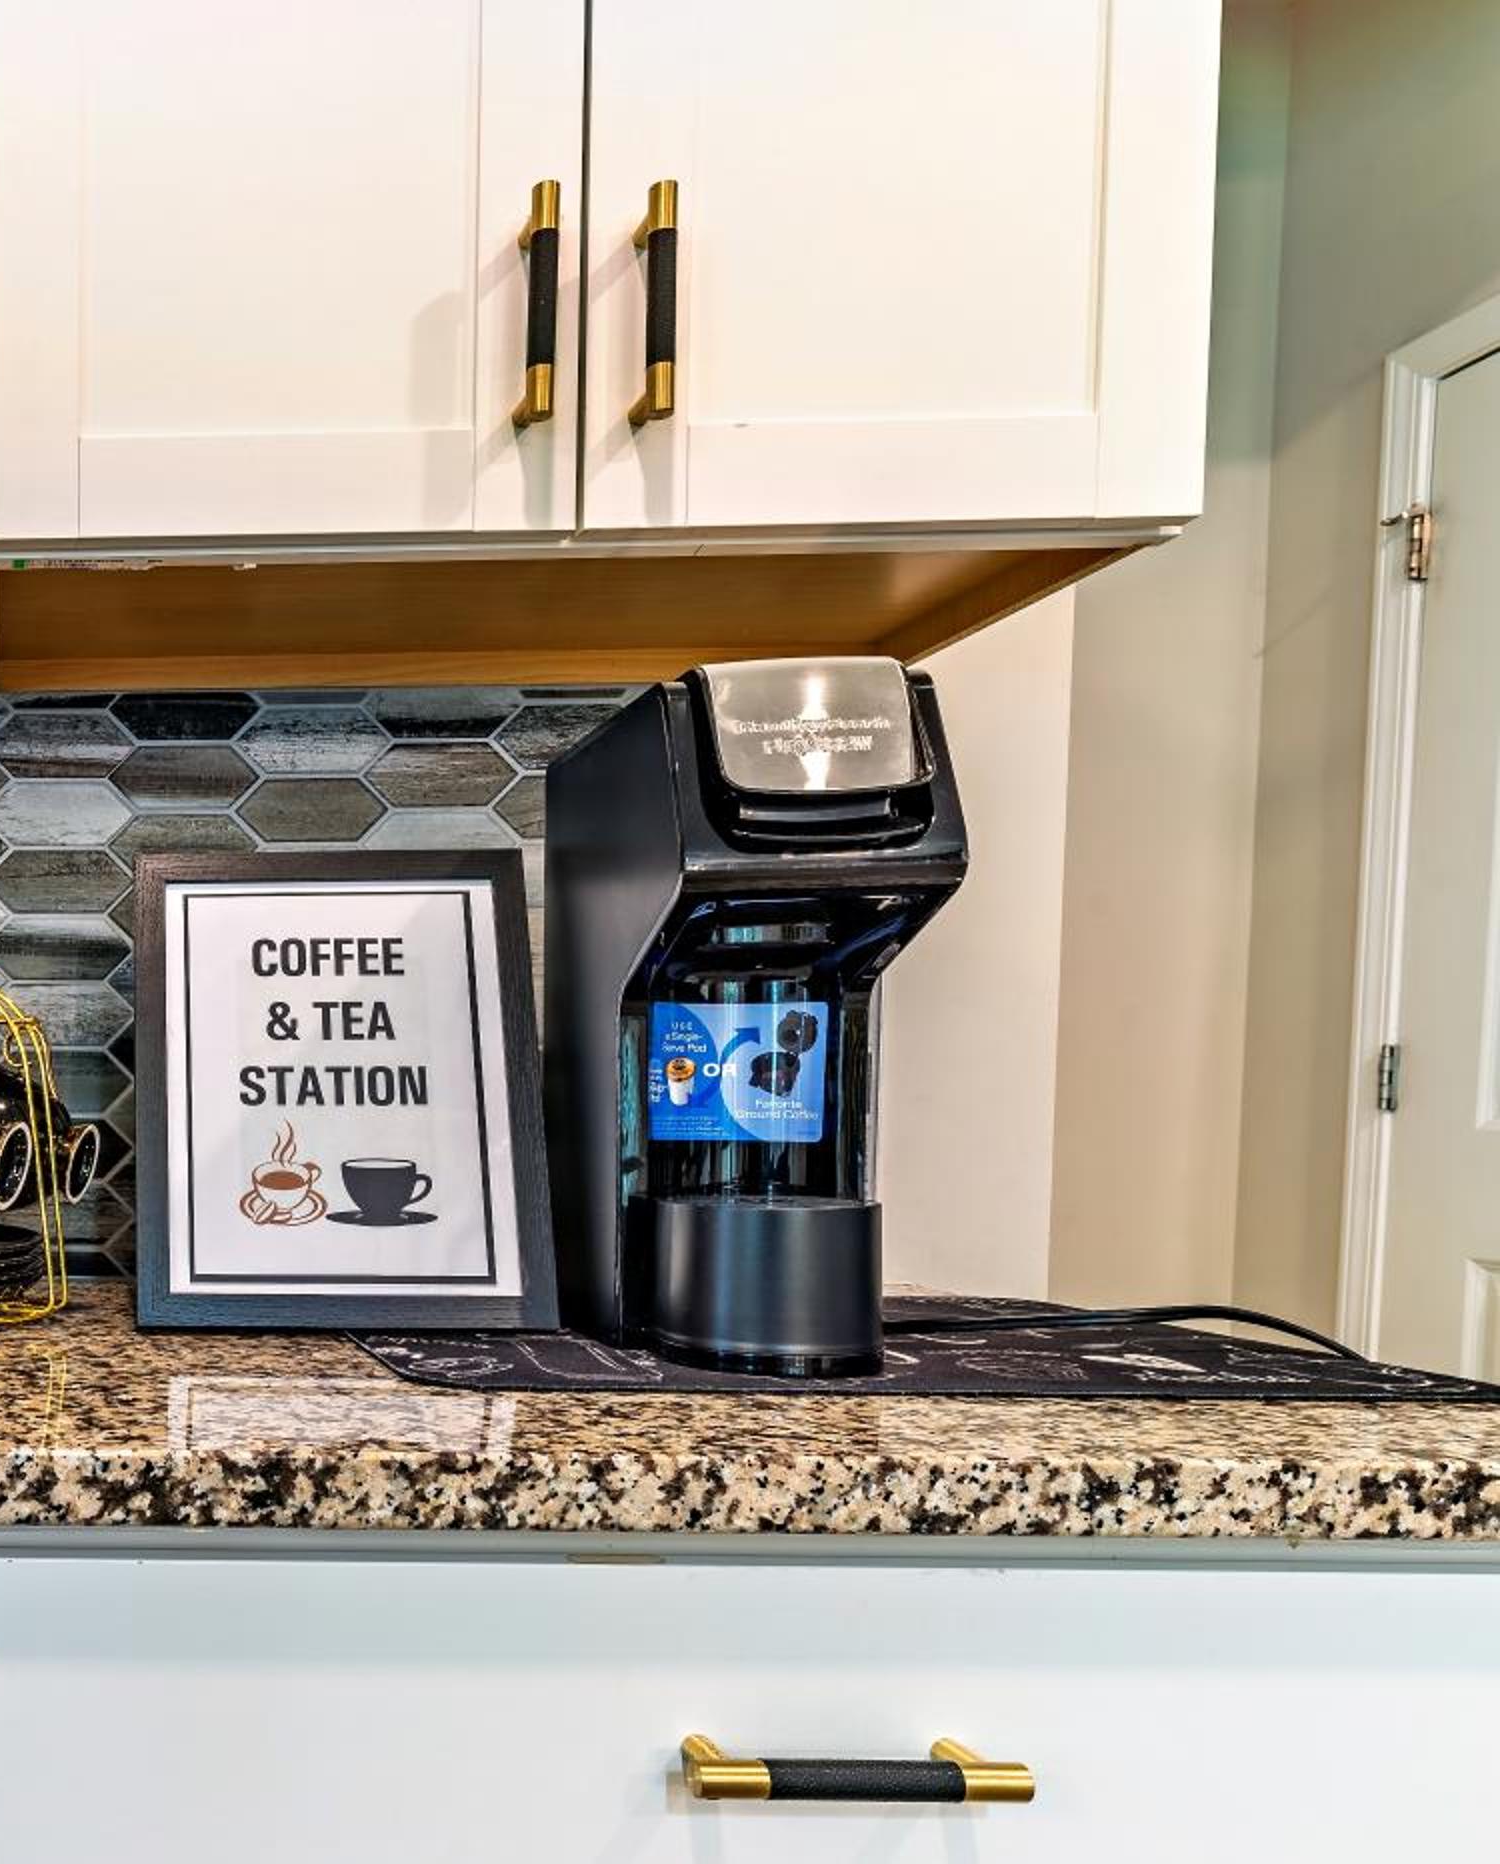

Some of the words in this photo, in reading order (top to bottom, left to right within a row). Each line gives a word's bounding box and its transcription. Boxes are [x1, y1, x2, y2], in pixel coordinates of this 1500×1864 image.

[251, 938, 405, 977] COFFEE
[266, 1001, 300, 1041] &
[313, 1001, 396, 1041] TEA
[238, 1065, 428, 1107] STATION
[702, 1063, 737, 1077] OR
